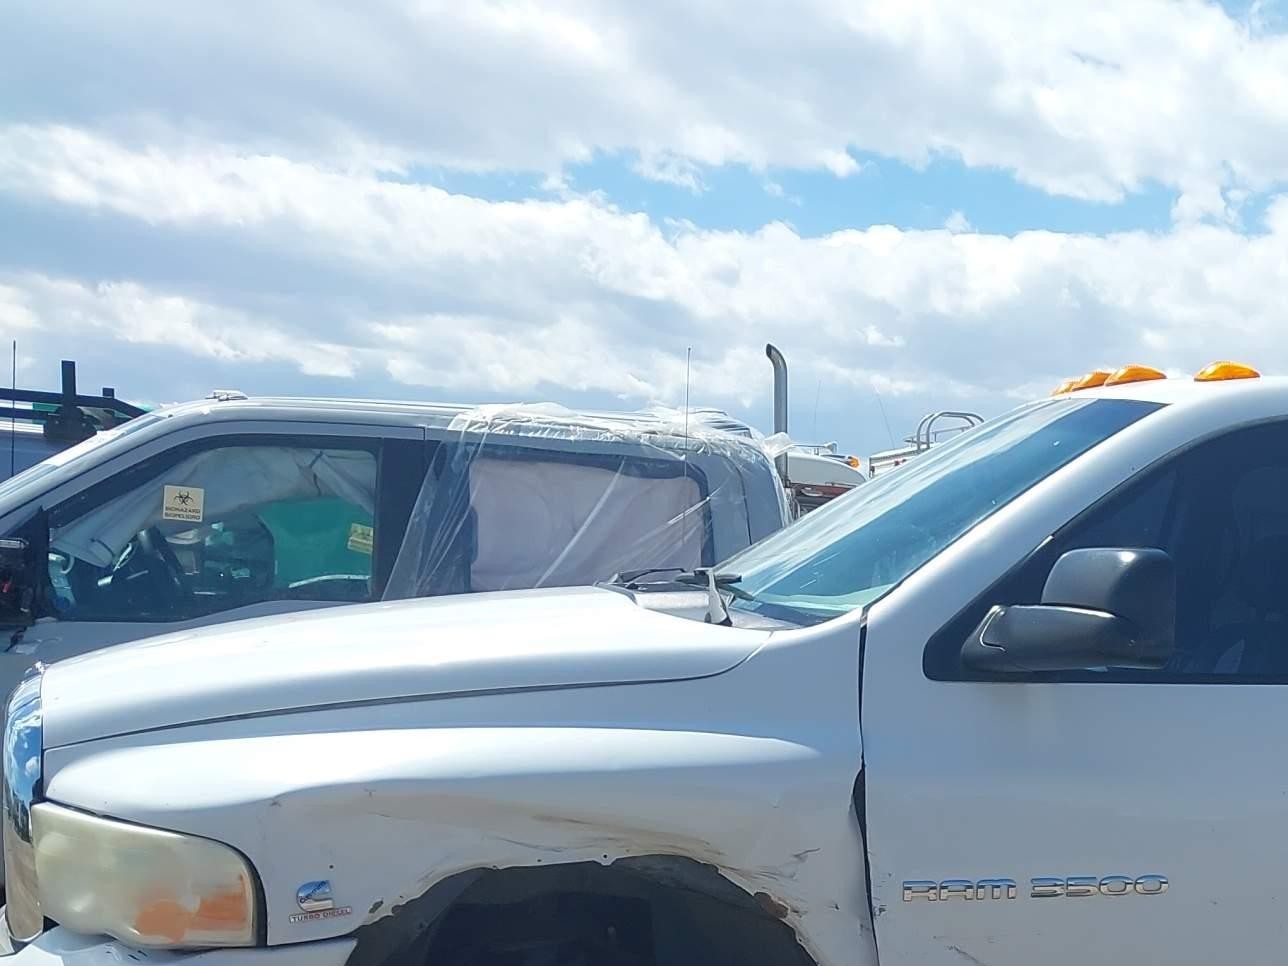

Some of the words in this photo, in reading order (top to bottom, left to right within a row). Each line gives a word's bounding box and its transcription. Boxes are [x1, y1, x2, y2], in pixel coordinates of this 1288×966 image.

[902, 879, 1017, 902] RAM
[1030, 874, 1169, 898] 3500
[292, 912, 321, 922] TURBO
